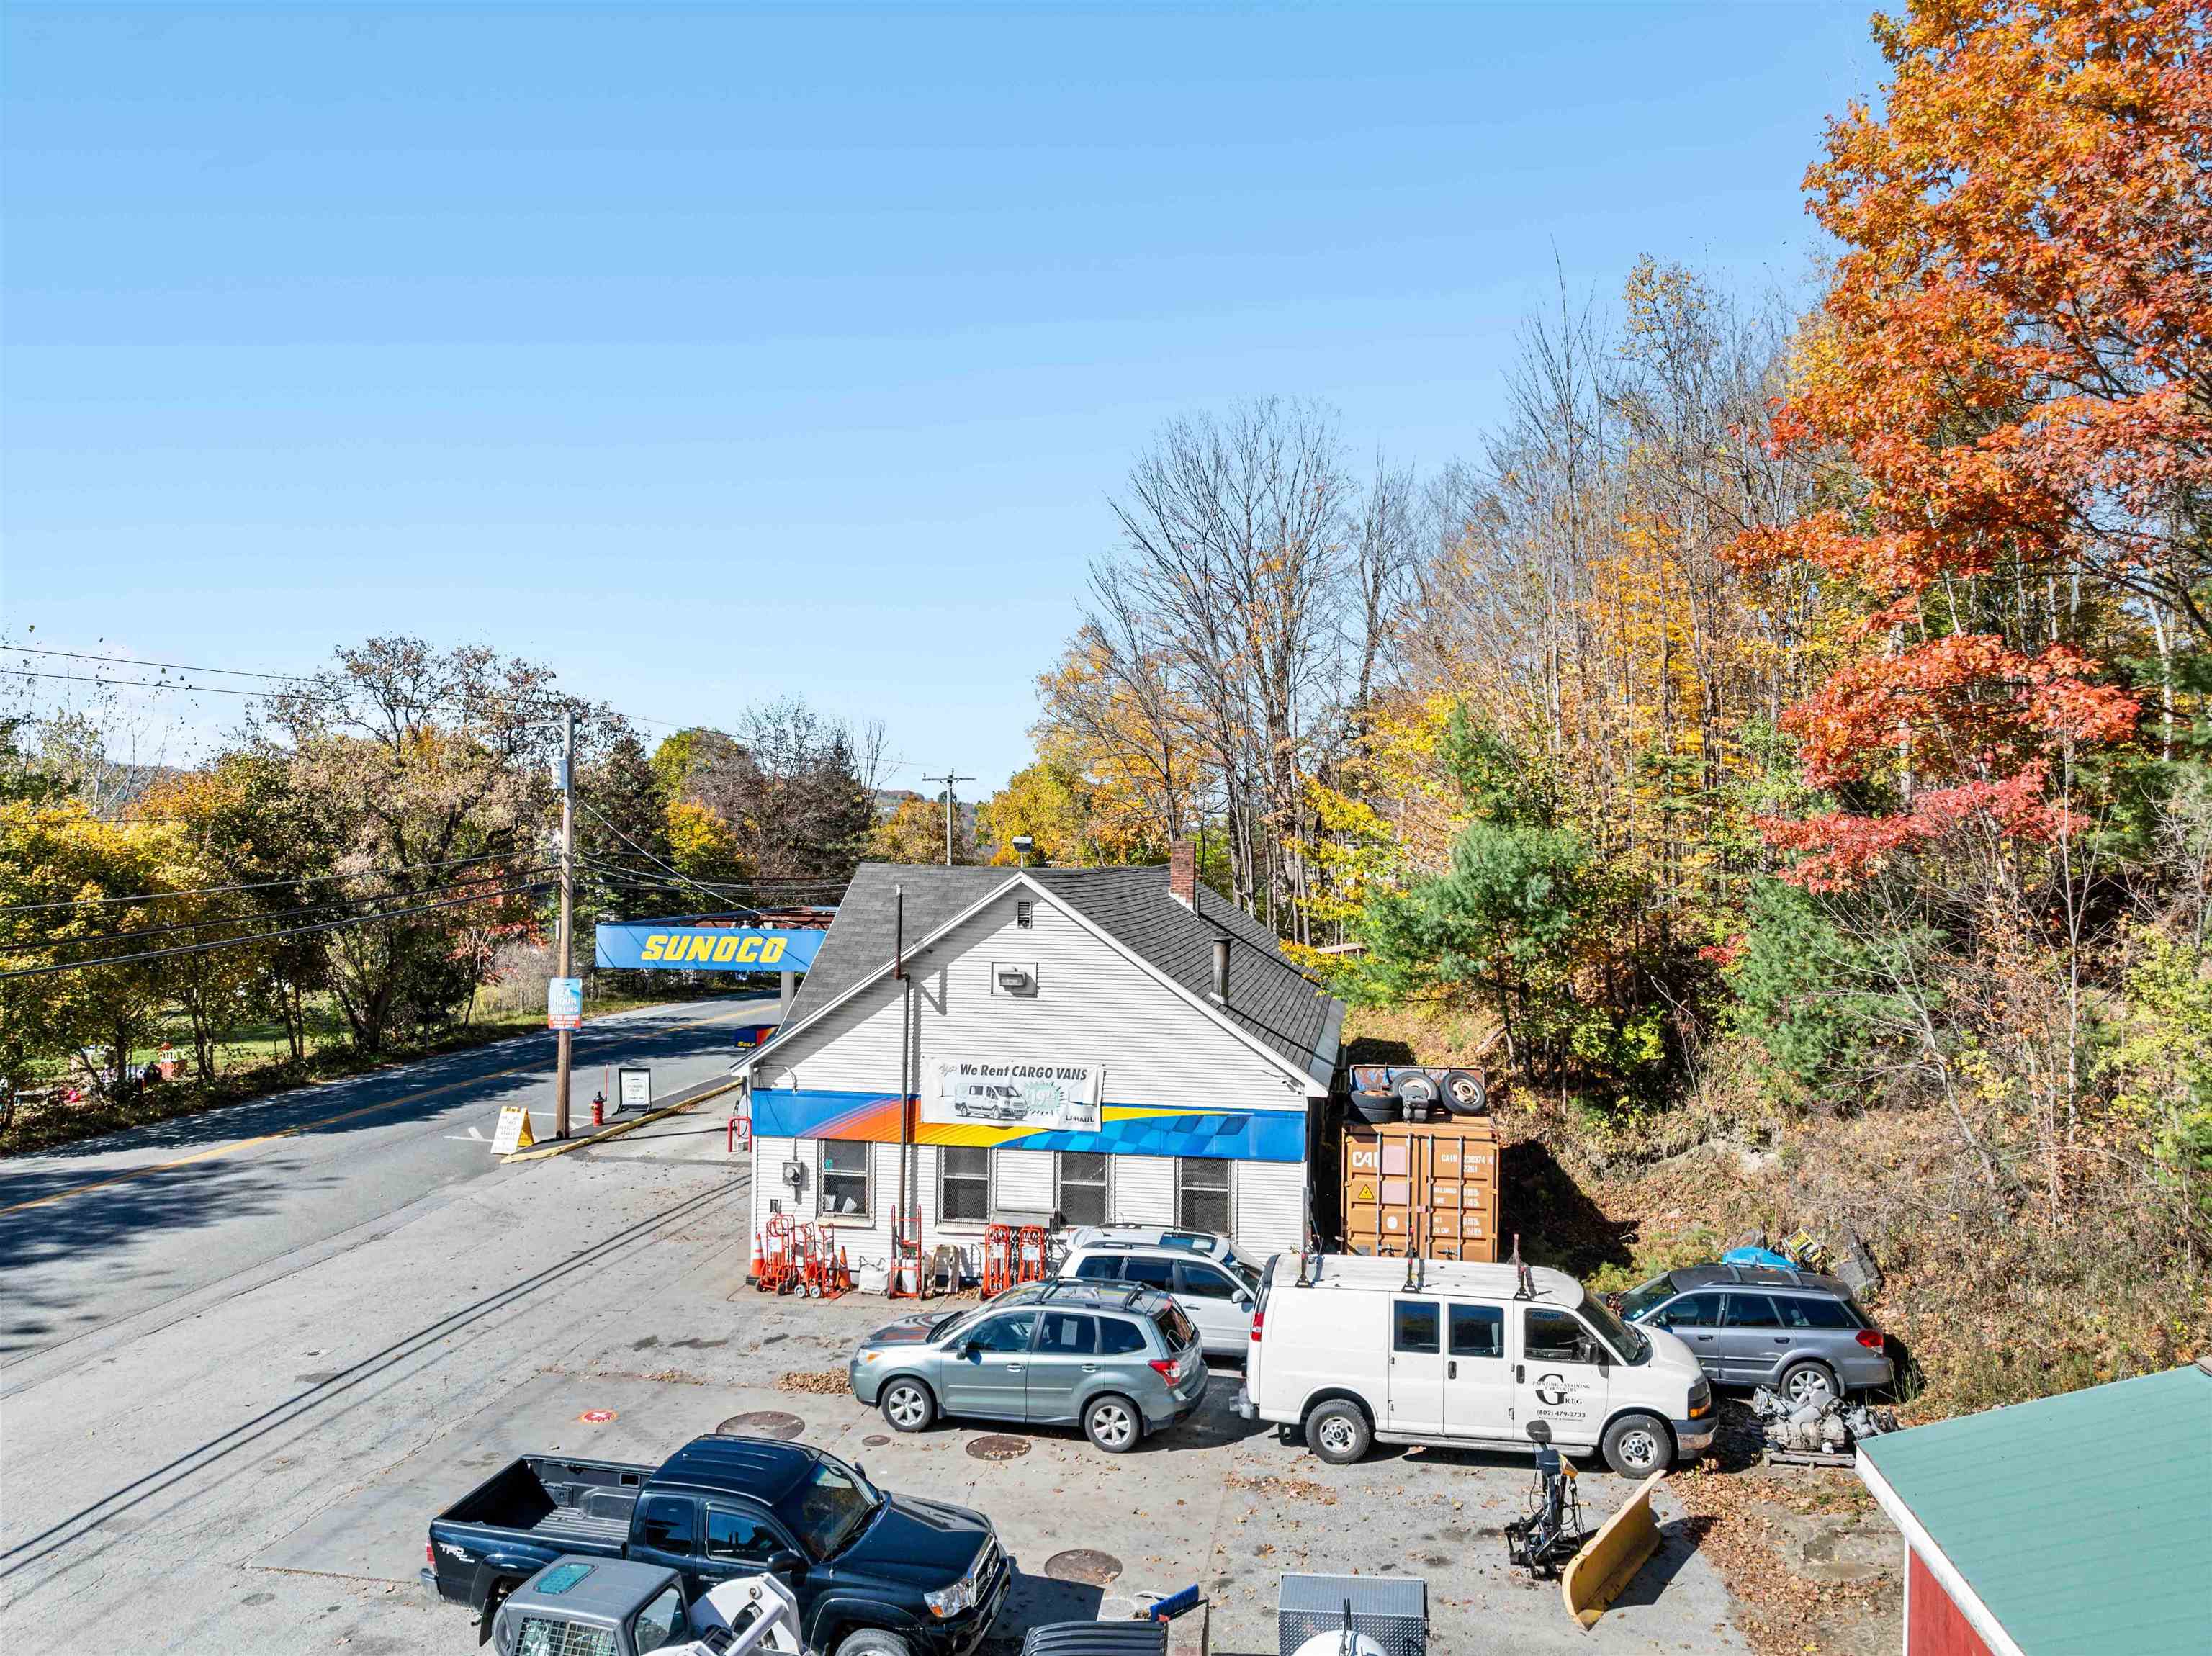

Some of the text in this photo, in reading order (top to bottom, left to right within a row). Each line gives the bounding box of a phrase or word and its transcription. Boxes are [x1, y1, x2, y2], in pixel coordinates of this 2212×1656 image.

[641, 935, 788, 963] SUNOCO
[553, 996, 577, 1006] HOUR
[960, 1063, 978, 1076] We
[981, 1064, 1009, 1076] Rent
[1011, 1066, 1053, 1079] CARGO
[1056, 1068, 1088, 1081] VANS
[1065, 1115, 1095, 1123] U-HAUL
[438, 1542, 464, 1555] TRD
